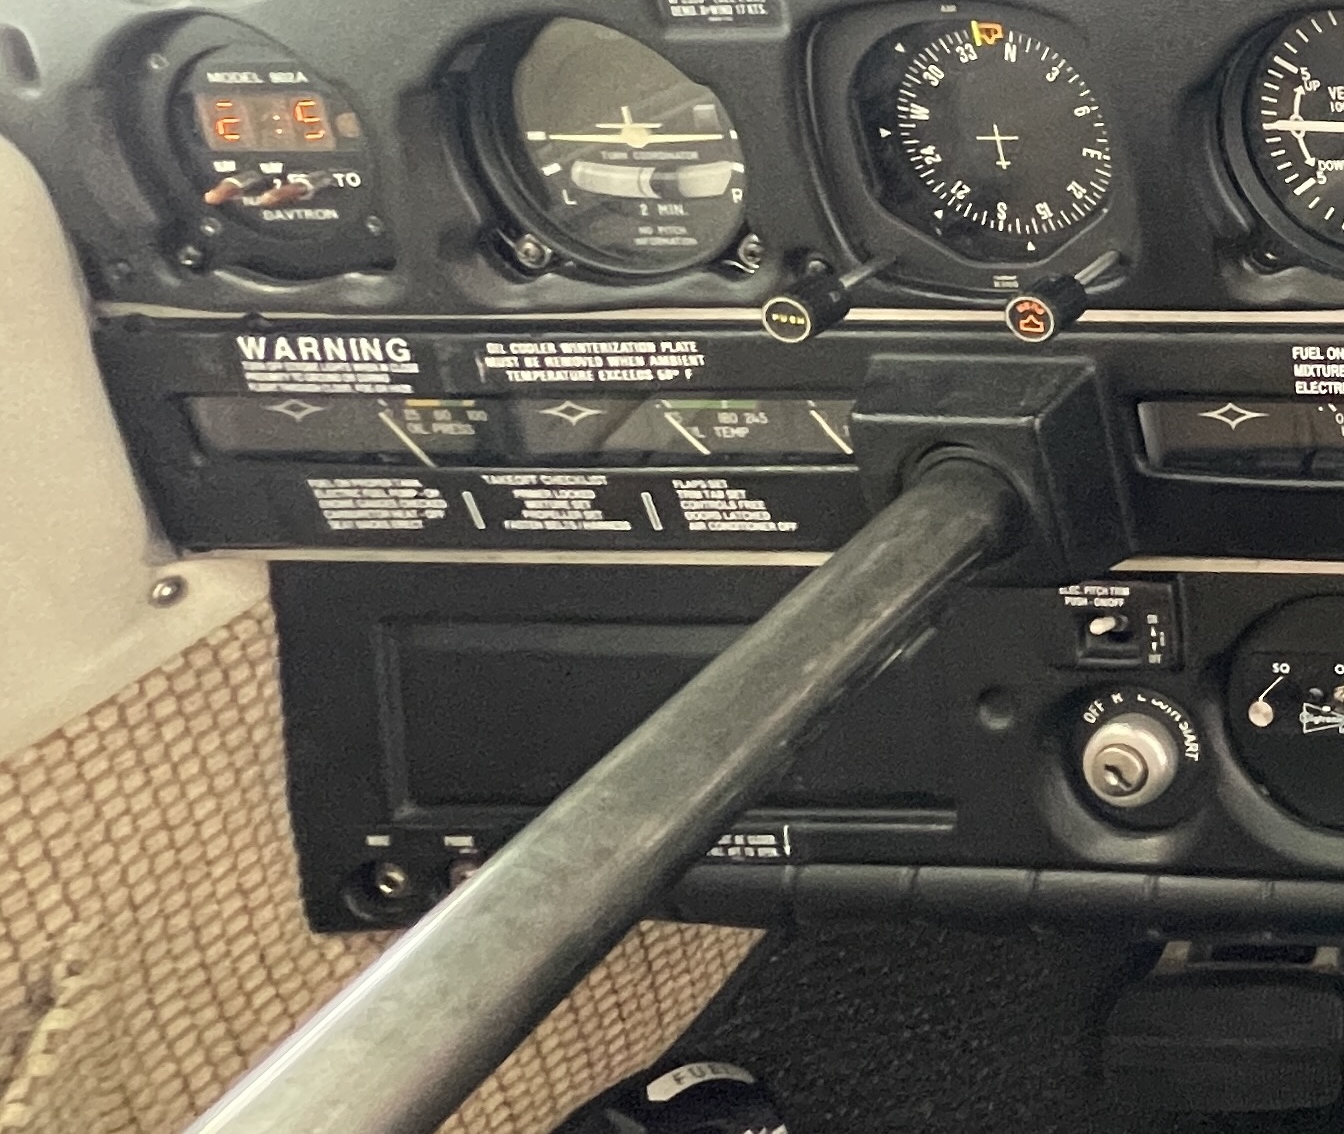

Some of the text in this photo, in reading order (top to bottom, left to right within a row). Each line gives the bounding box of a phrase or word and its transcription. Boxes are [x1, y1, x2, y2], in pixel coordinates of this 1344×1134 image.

[955, 43, 978, 63] 33
[1004, 43, 1017, 62] N
[237, 336, 412, 362] WARNING
[1292, 346, 1324, 361] FUEL
[1326, 347, 1344, 361] ON
